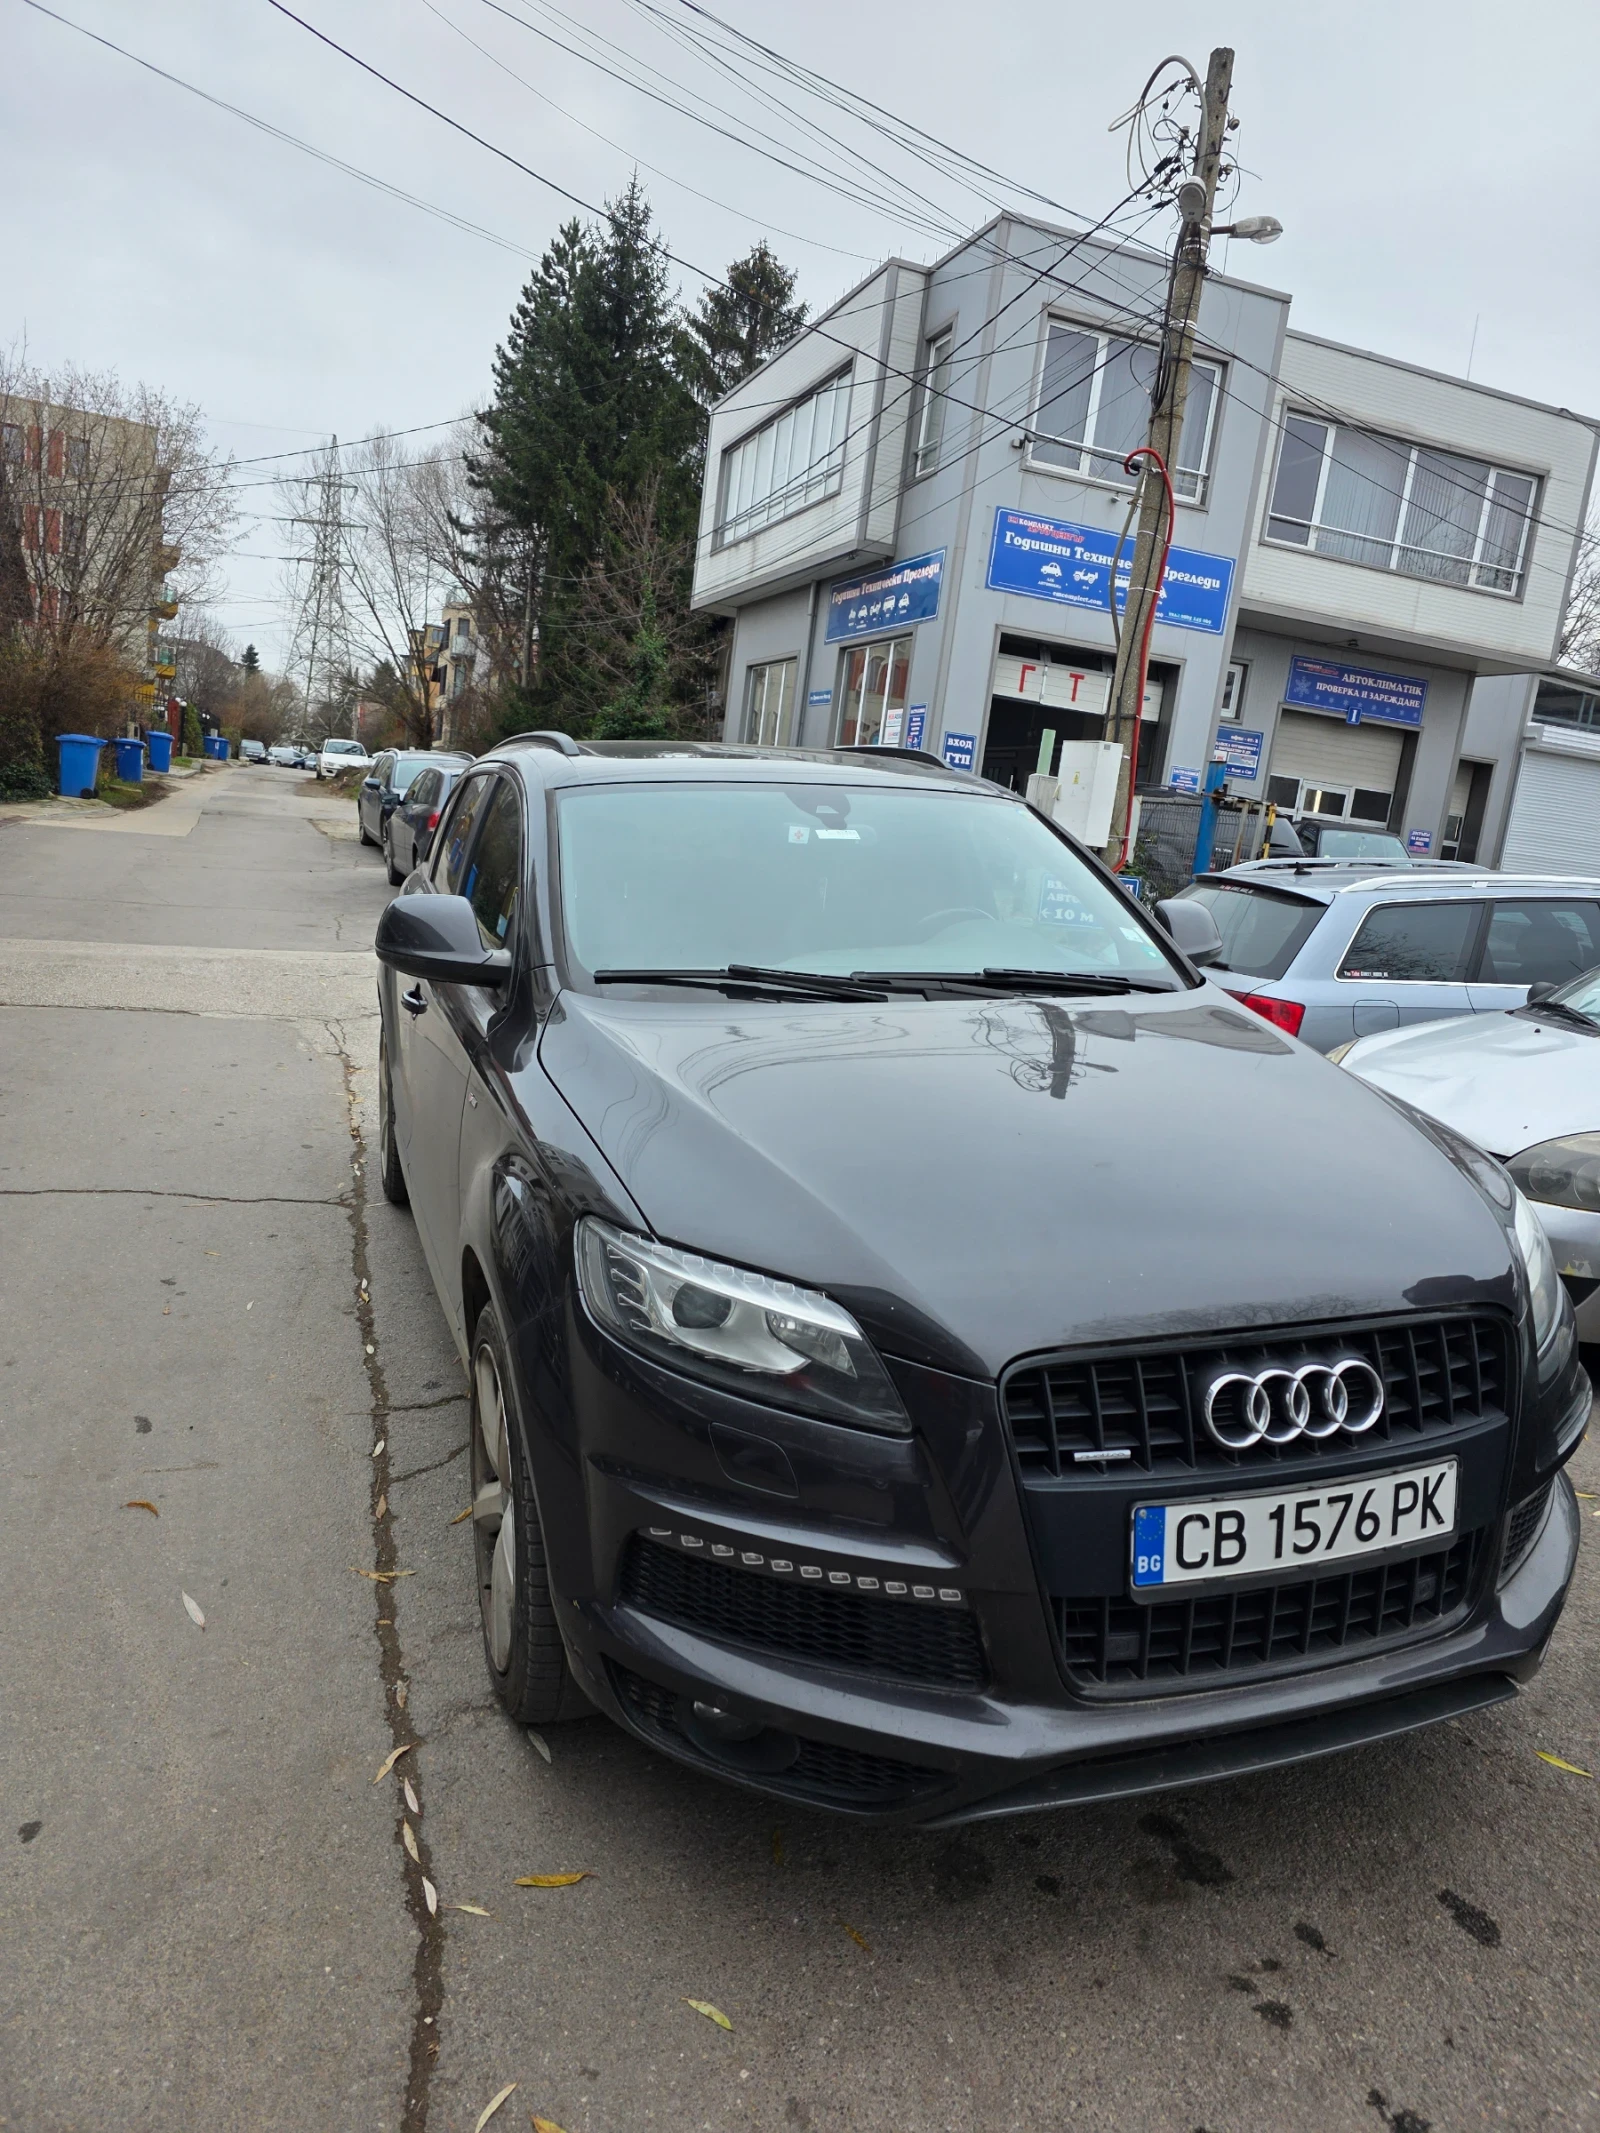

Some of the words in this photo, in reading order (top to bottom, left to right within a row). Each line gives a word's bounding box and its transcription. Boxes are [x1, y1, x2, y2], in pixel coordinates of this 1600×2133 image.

[1004, 531, 1071, 557] Годишни
[1074, 546, 1133, 570] Техниче
[832, 587, 861, 605] Годишни
[861, 573, 902, 595] Технически
[903, 562, 940, 584] Прегледи
[1019, 664, 1036, 693] Г
[1341, 673, 1422, 696] АВТОКЛИМАТИК
[1315, 682, 1360, 697] ПРОВЕРКА
[1361, 690, 1368, 699] И
[1369, 692, 1421, 708] ЗАРЕЖДАНЕ
[1351, 709, 1359, 722] 1
[947, 738, 973, 750] ВХОД
[946, 752, 971, 765] ГТП
[1054, 908, 1075, 920] 10
[1175, 1509, 1247, 1570] CB
[1269, 1488, 1380, 1559] 1576
[1390, 1472, 1447, 1537] PK
[1137, 1555, 1161, 1573] BG
